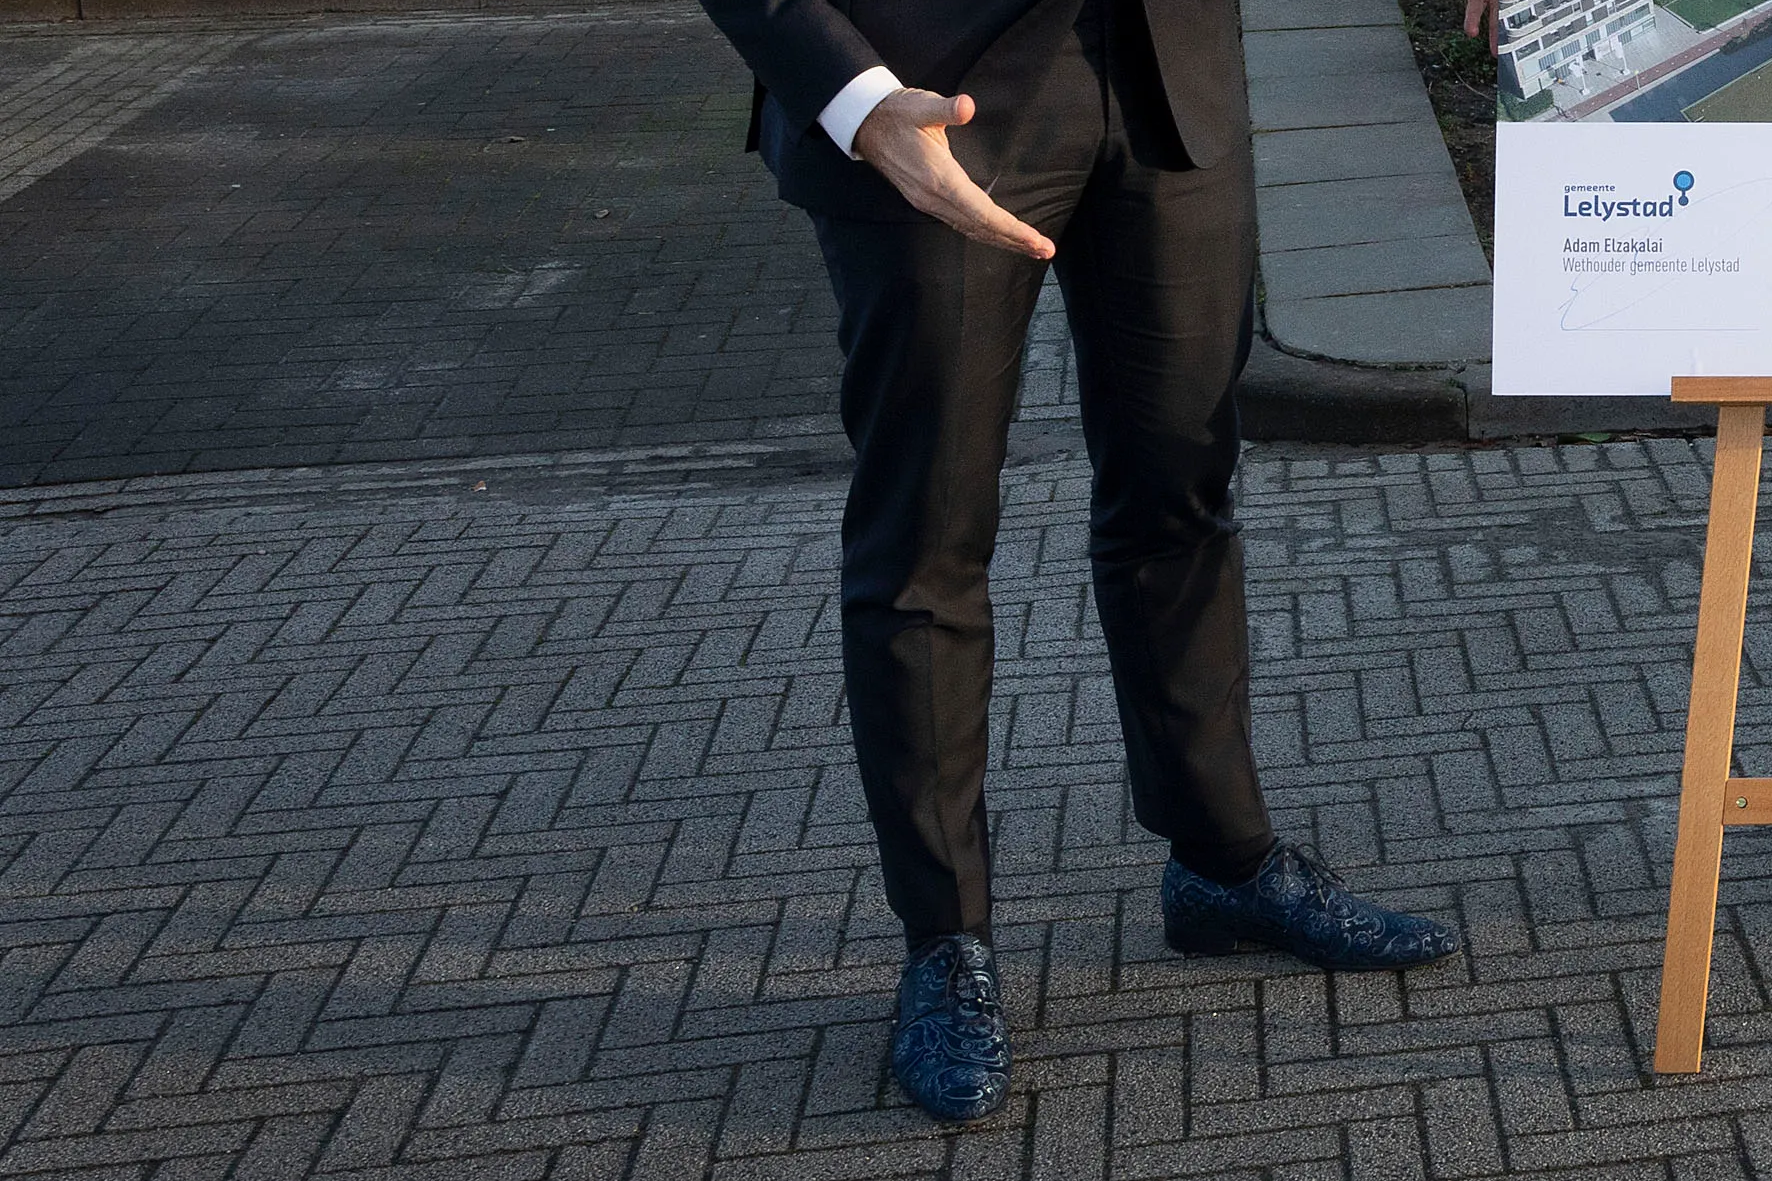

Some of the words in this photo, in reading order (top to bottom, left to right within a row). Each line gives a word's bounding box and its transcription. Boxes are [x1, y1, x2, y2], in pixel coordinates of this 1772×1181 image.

[1564, 184, 1616, 194] gemeente
[1563, 194, 1674, 222] Lelystad
[1562, 237, 1600, 253] Adam
[1604, 237, 1664, 254] Elzakalai
[1562, 257, 1626, 273] Wethouder
[1629, 260, 1688, 276] gemeente
[1691, 257, 1741, 275] Lelystad
